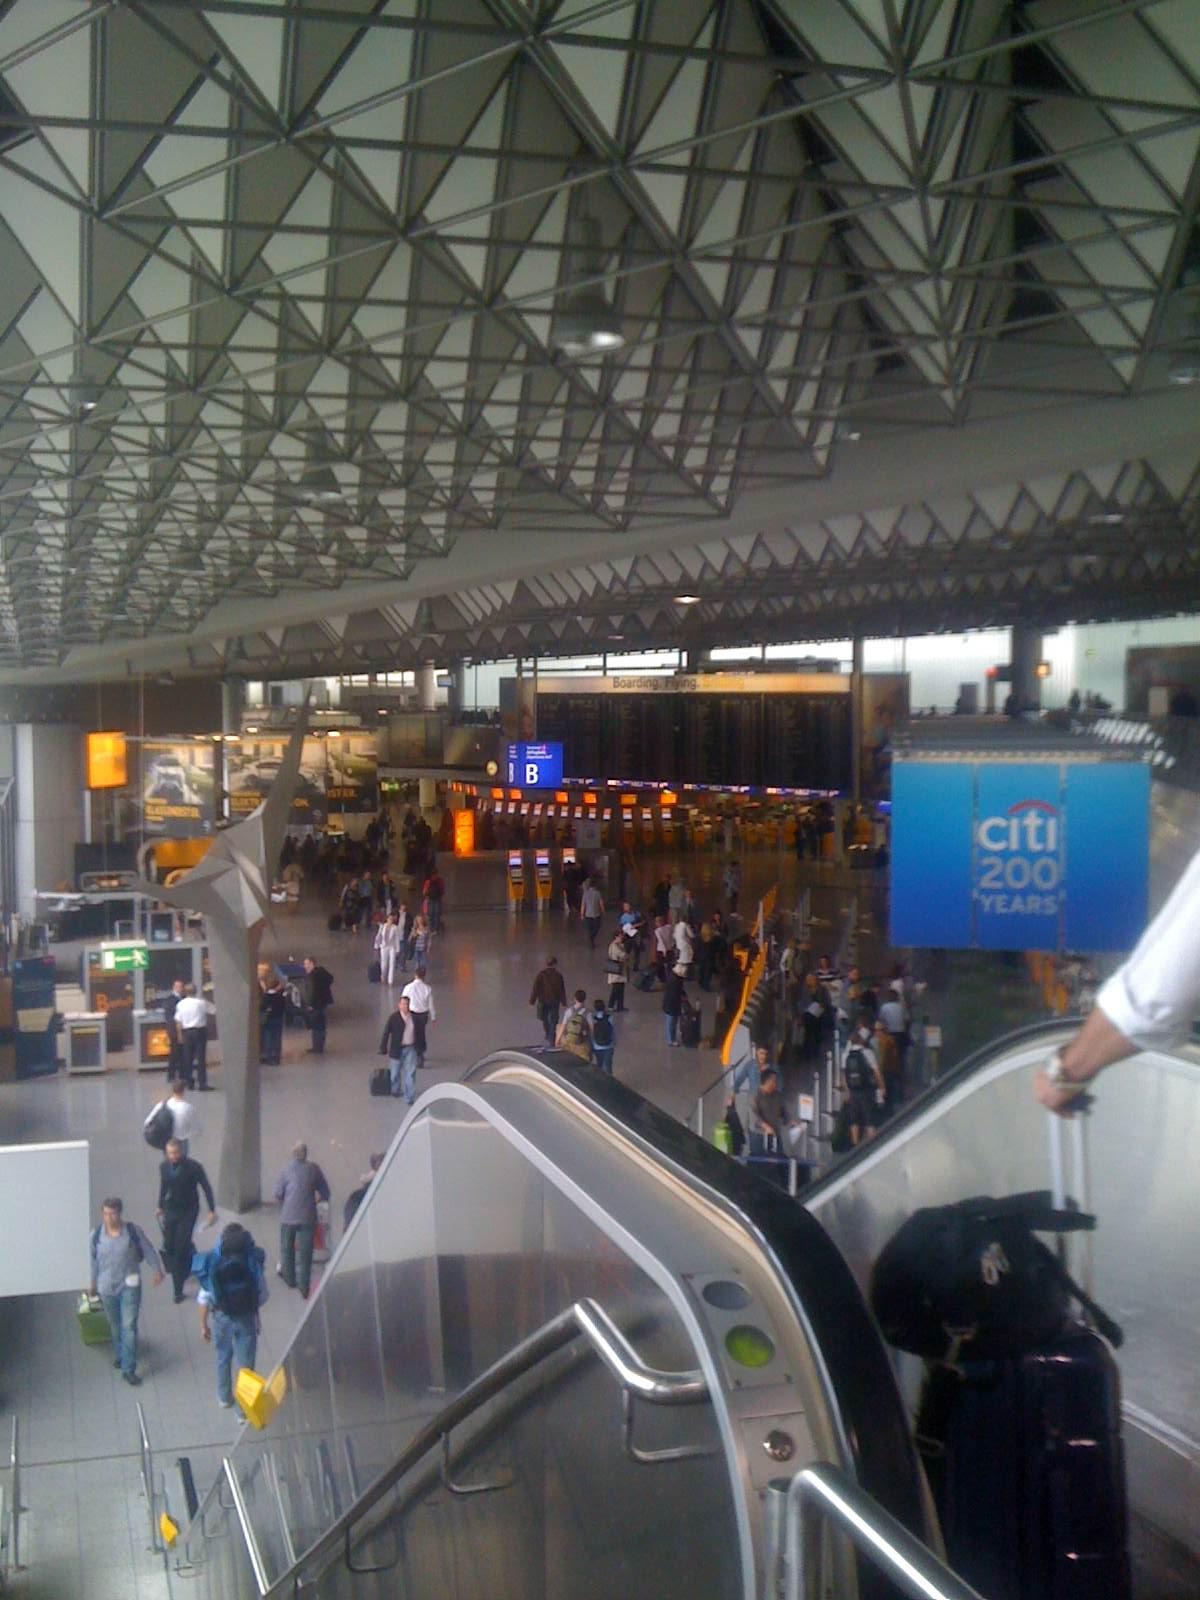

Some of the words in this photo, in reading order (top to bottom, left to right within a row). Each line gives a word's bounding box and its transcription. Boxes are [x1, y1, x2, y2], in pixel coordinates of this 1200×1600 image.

[526, 763, 538, 784] B
[979, 808, 1057, 852] citi
[979, 857, 1059, 889] 200
[981, 894, 1058, 914] YEARS
